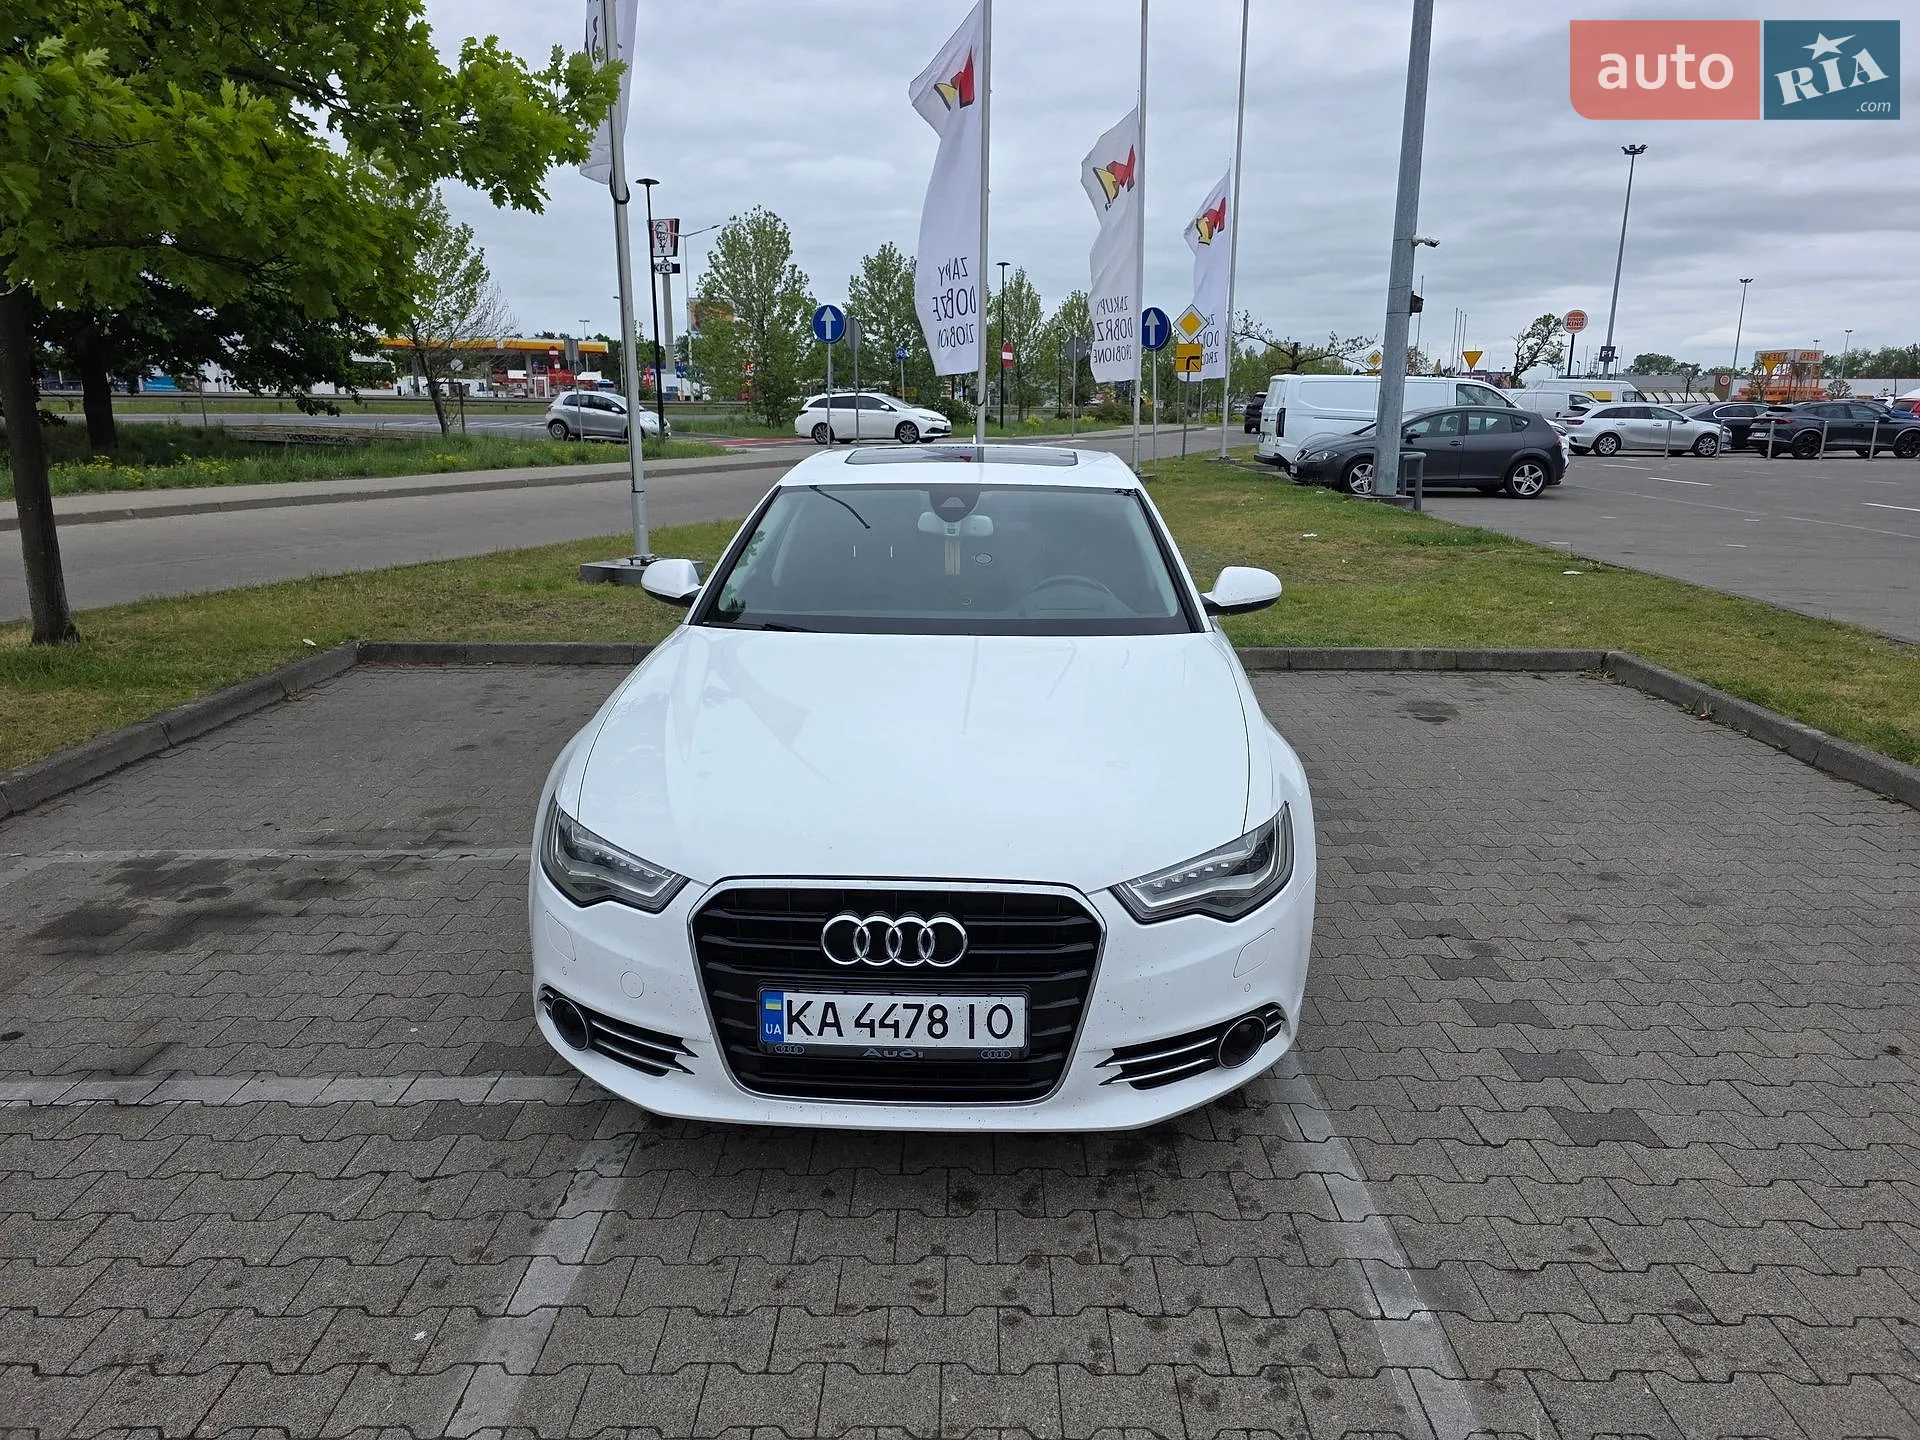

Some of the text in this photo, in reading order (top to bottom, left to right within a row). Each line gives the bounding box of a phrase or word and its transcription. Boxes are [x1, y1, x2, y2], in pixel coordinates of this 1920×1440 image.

[654, 263, 672, 272] KFC
[787, 999, 1014, 1040] KA 4478 IO
[765, 1023, 782, 1036] UA
